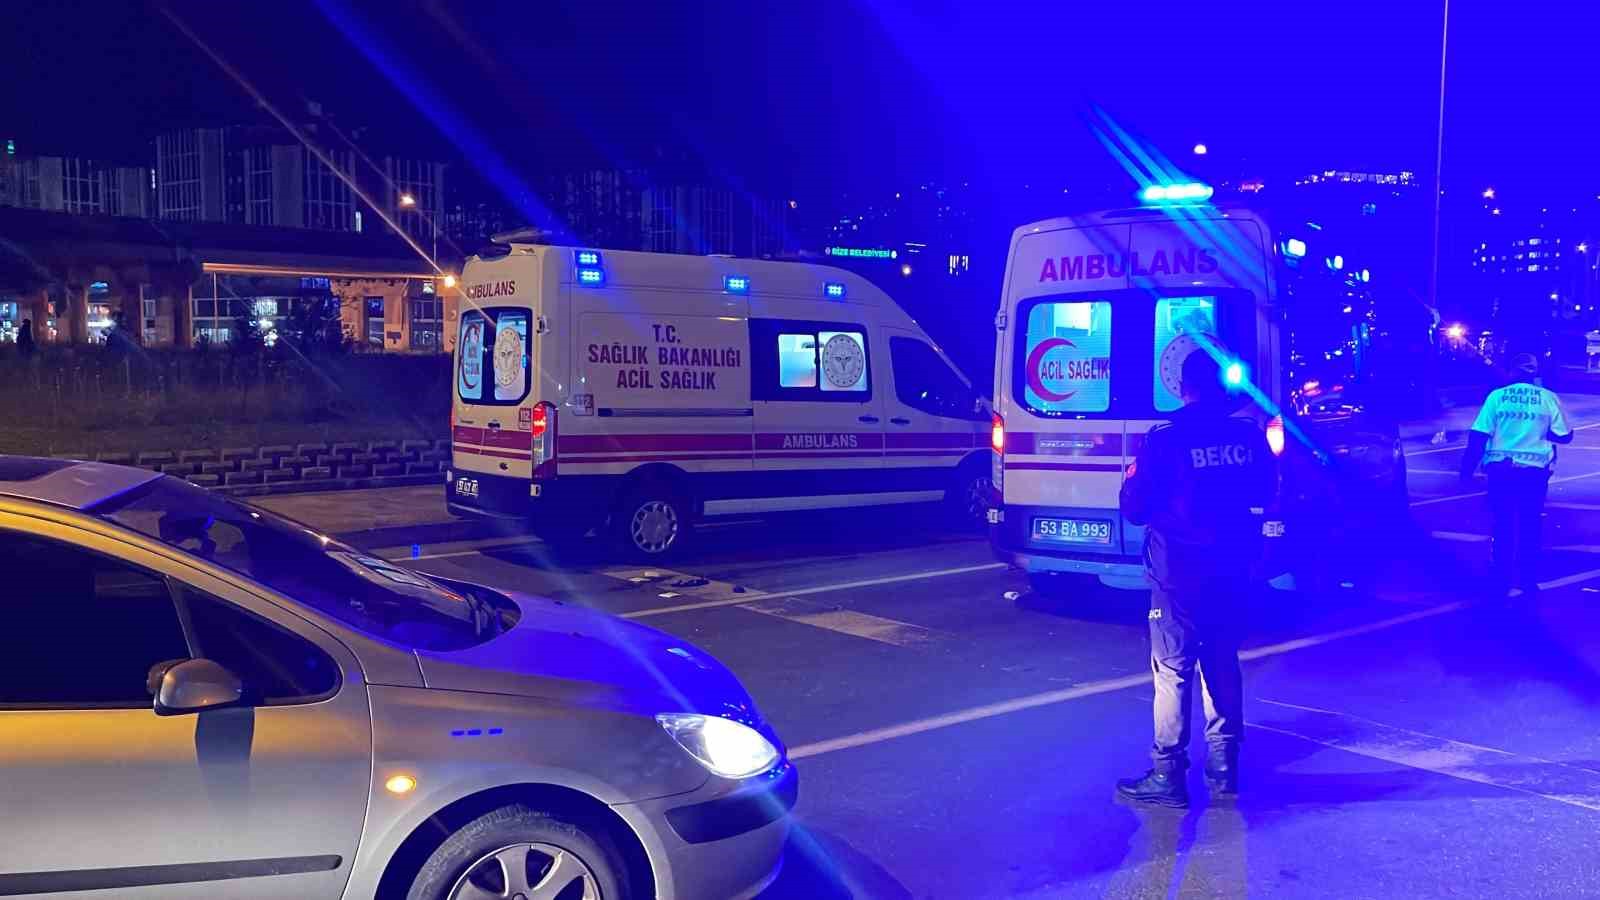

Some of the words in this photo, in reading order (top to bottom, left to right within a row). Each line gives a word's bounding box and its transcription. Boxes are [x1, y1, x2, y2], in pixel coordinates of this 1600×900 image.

[1039, 249, 1218, 282] AMBULANS
[652, 324, 681, 343] T.C.
[588, 342, 648, 364] SAĞLIK
[658, 346, 741, 368] BAKANLIĞI
[616, 367, 653, 389] ACİL
[660, 369, 716, 390] SAĞLIK
[1041, 358, 1065, 380] ACİL
[783, 434, 858, 449] AMBULANS
[1040, 520, 1057, 535] 53
[1060, 521, 1078, 537] BA
[1081, 523, 1108, 537] 993
